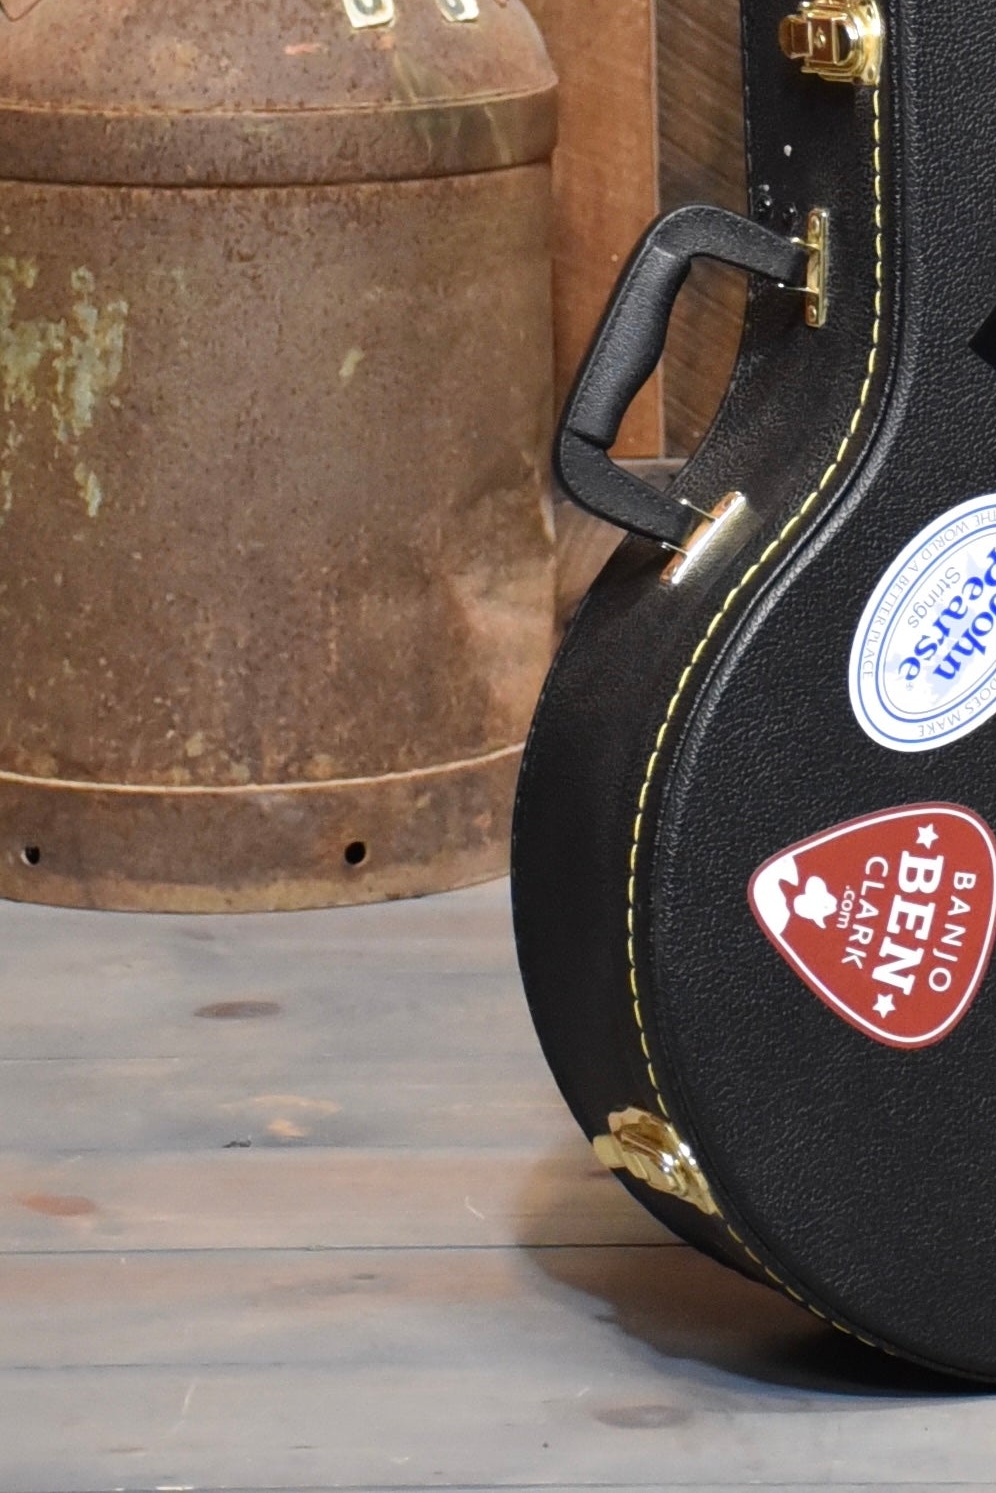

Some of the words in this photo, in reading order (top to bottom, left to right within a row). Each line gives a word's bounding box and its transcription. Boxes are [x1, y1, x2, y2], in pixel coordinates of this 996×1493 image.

[908, 560, 919, 572] A
[921, 522, 970, 560] WORLD
[875, 575, 910, 627] BETTER
[907, 566, 961, 628] Strings
[862, 629, 881, 680] PLACE
[917, 710, 961, 737] MAKE
[836, 885, 856, 929] .com
[841, 856, 889, 970] CLARK
[871, 850, 945, 995] BEN
[928, 871, 977, 993] BANJO
